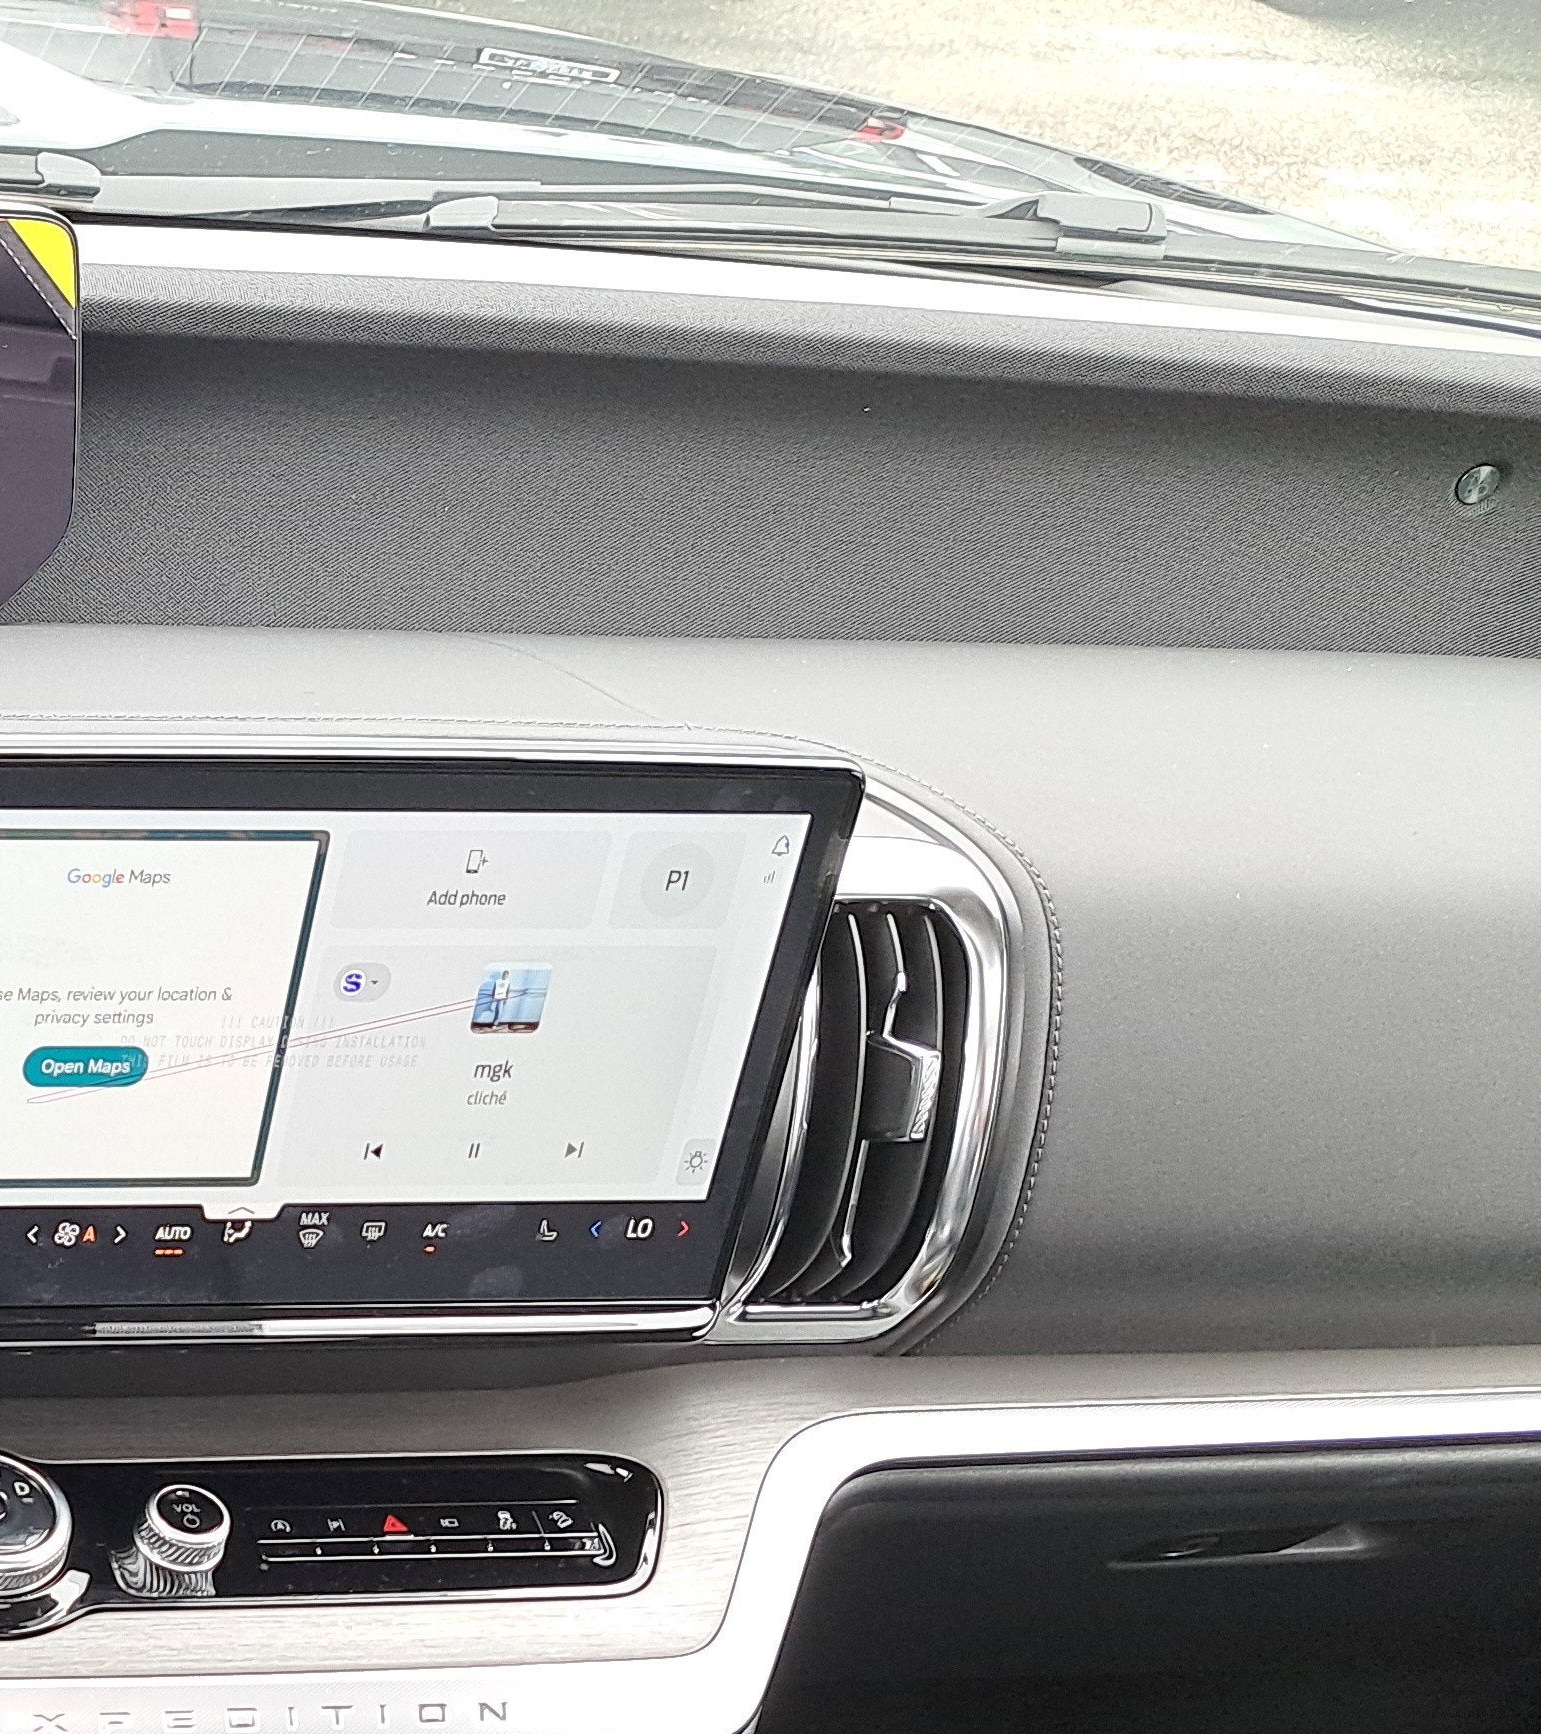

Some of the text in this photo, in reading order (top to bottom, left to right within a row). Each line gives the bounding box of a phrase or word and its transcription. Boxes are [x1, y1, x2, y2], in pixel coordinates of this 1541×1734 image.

[68, 869, 171, 888] Google Maps
[665, 870, 688, 891] P1
[427, 890, 506, 907] Add phone
[17, 987, 61, 1005] Maps,
[66, 987, 115, 1002] review
[120, 990, 152, 1006] your
[158, 986, 217, 1003] location
[221, 987, 232, 1001] &
[34, 1009, 154, 1028] privacy settings
[41, 1058, 131, 1078] Open Maps
[474, 1059, 513, 1081] mgk
[467, 1089, 507, 1106] cliché
[300, 1212, 329, 1226] MAX
[625, 1218, 654, 1239] LO
[83, 1224, 97, 1243] A
[155, 1225, 191, 1241] AUTO
[422, 1223, 450, 1239] A/C
[14, 1482, 30, 1496] D
[173, 1502, 201, 1515] VOL
